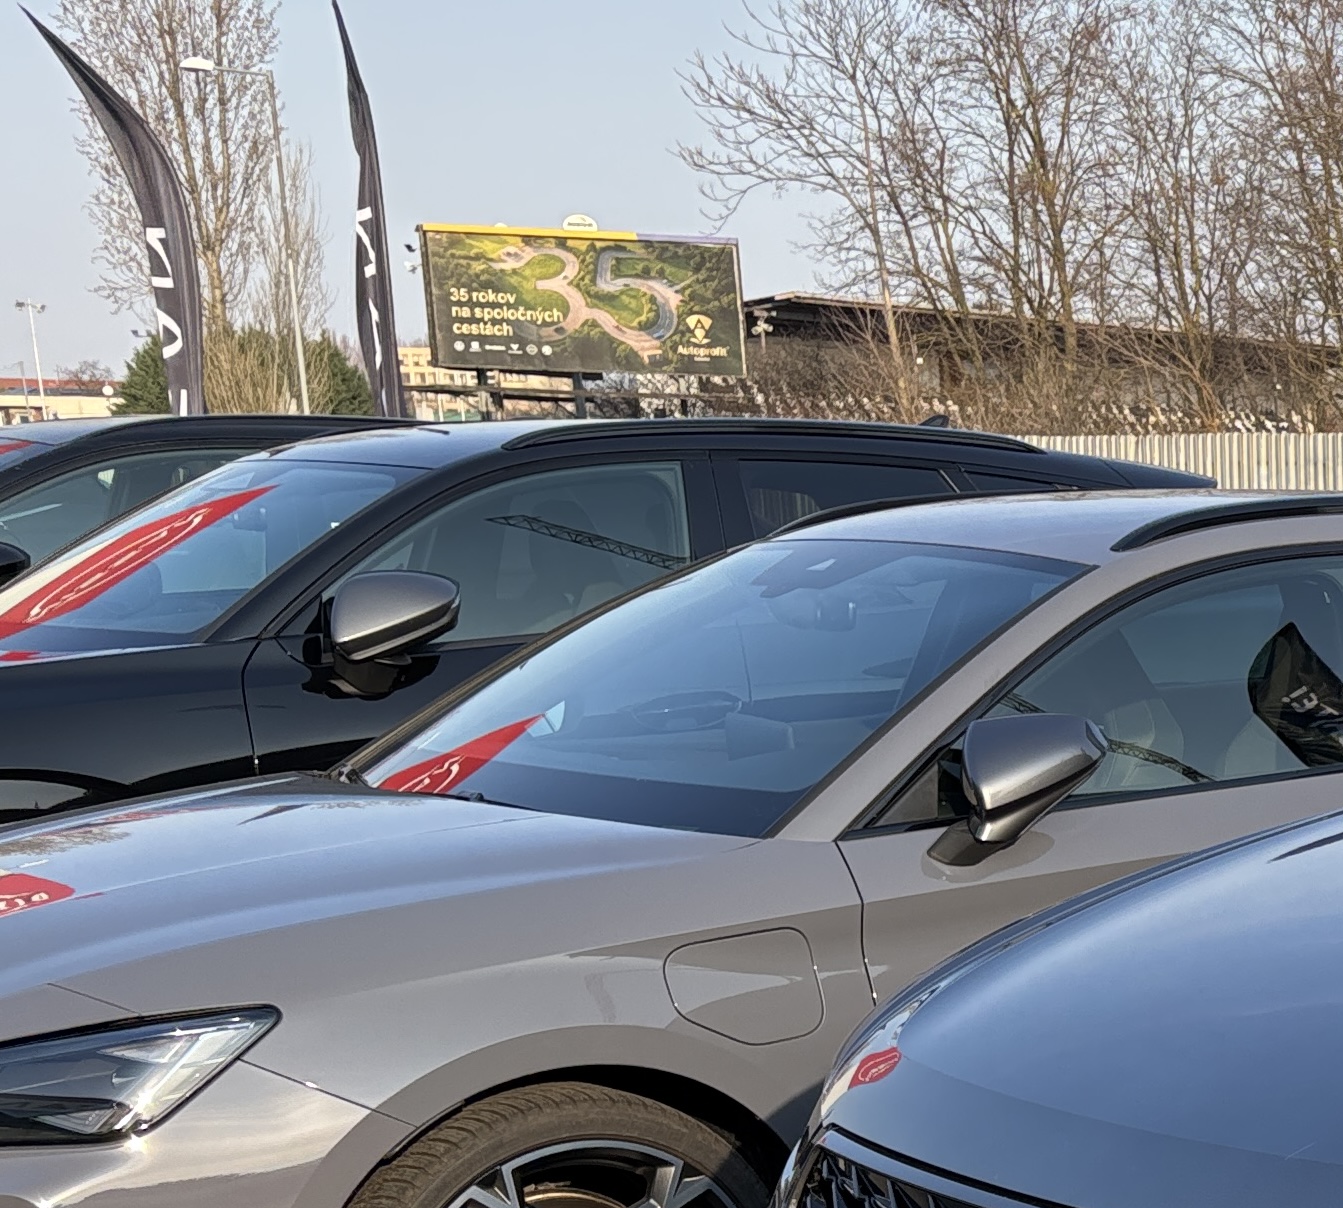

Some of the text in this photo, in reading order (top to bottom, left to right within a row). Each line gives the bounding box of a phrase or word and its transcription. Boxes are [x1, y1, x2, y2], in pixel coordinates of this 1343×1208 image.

[450, 287, 516, 305] 35 rokov
[452, 305, 564, 324] na spoločných
[453, 321, 514, 338] cestách
